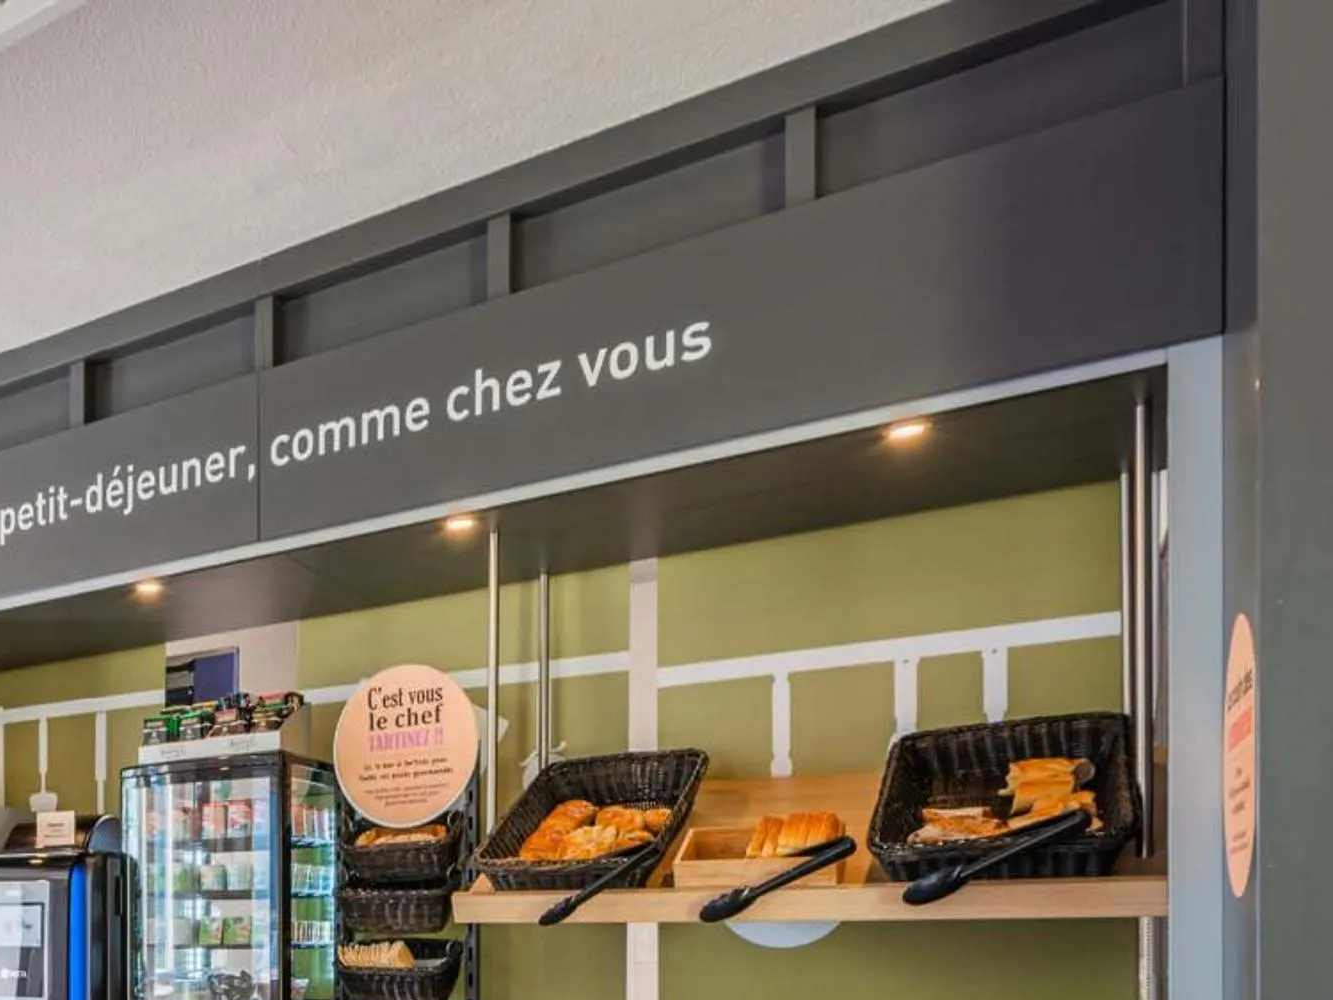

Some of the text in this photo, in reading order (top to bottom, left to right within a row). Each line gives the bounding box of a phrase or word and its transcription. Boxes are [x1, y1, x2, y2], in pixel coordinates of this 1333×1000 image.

[270, 396, 430, 467] comme
[446, 367, 562, 421] chez
[578, 321, 712, 387] vous
[367, 687, 443, 710] C'est vous
[369, 703, 443, 731] le chef
